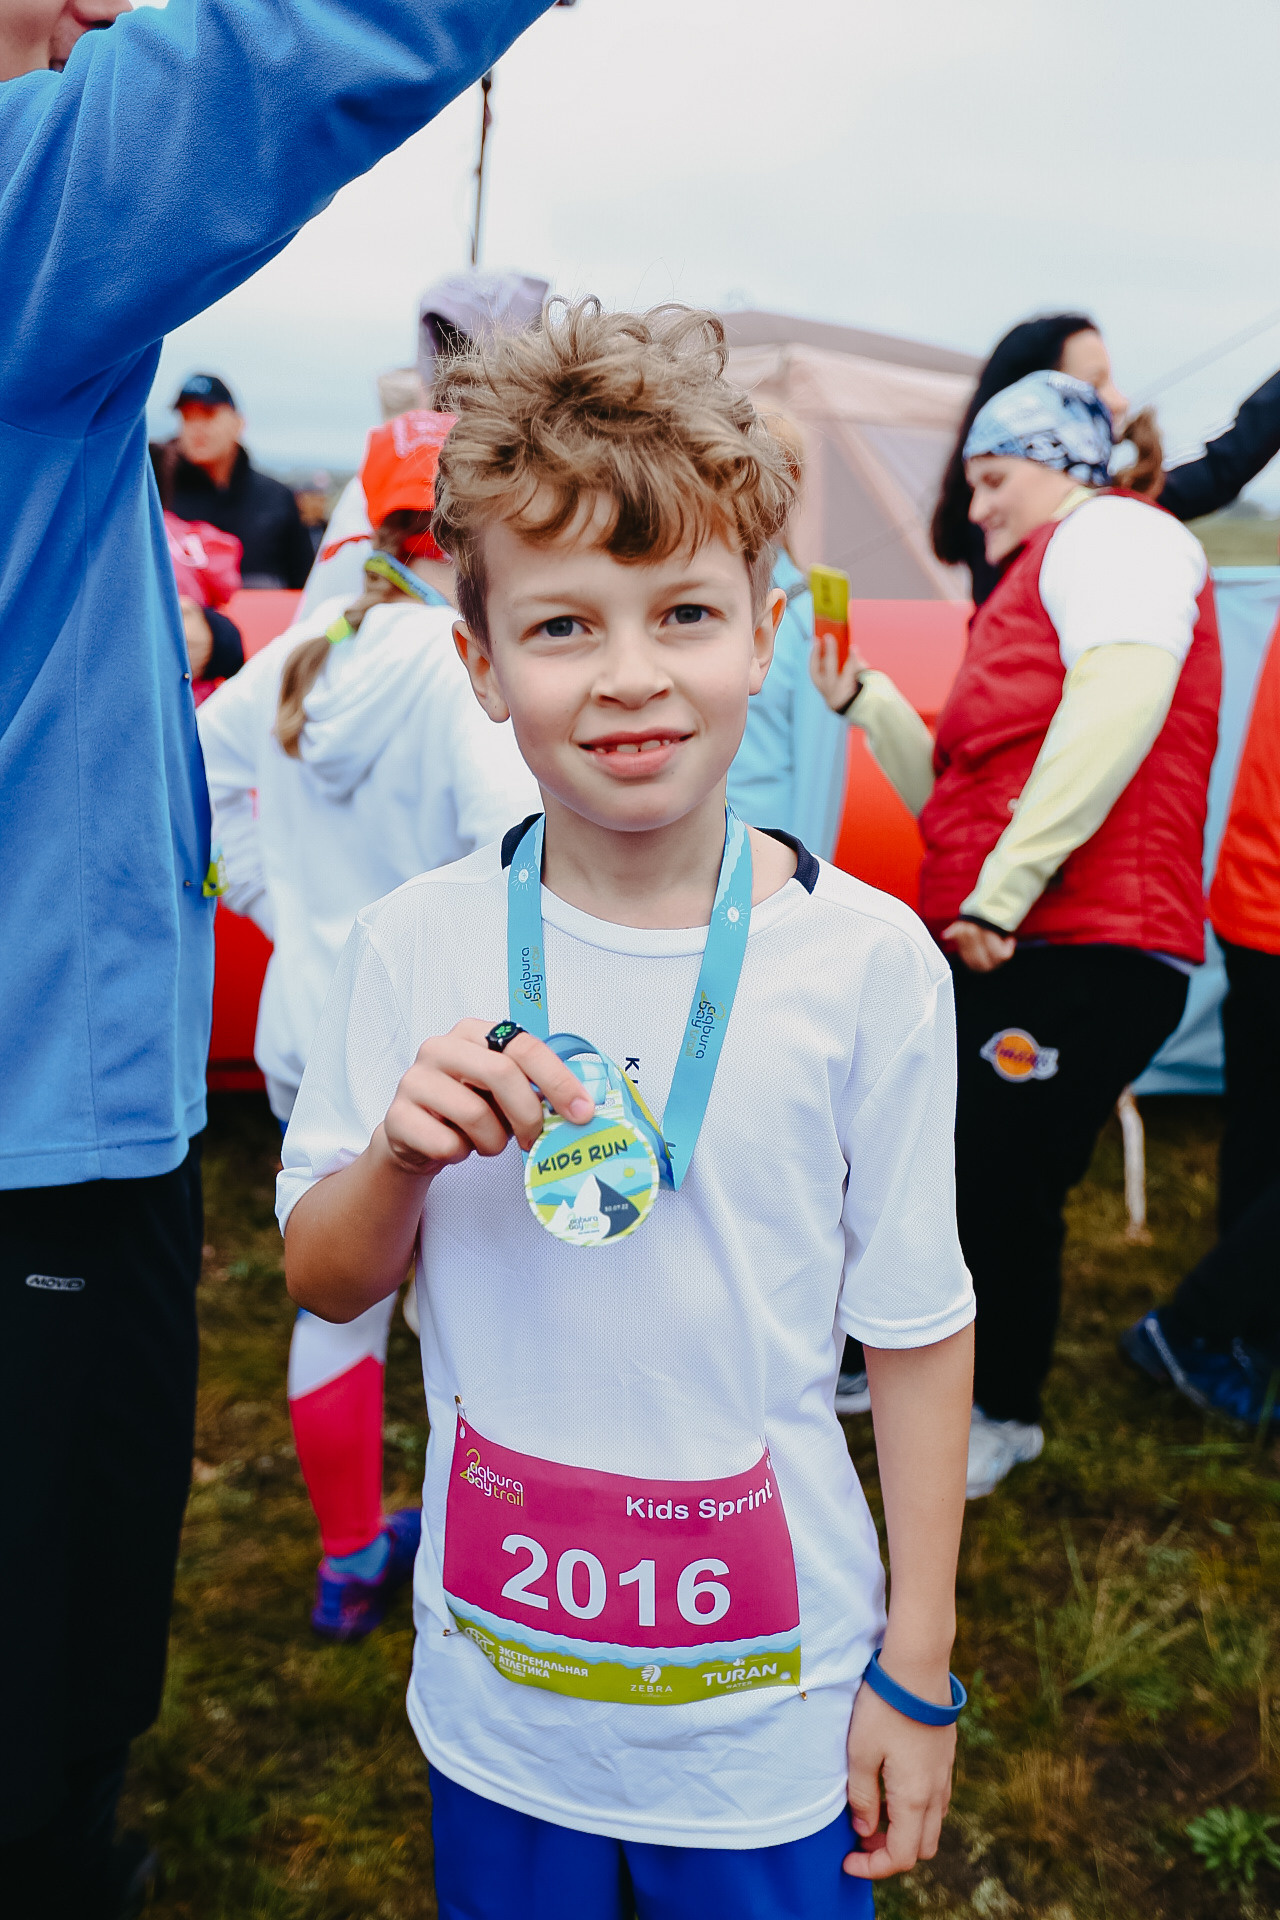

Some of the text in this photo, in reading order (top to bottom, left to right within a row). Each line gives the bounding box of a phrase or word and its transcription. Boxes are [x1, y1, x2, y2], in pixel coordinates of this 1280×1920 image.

[519, 947, 533, 999] aqbura
[530, 974, 543, 1002] bay
[691, 1001, 712, 1028] bay
[695, 1006, 716, 1059] aqbura
[537, 1139, 628, 1175] KIDS RUN
[466, 1466, 524, 1507] bay trail
[469, 1461, 524, 1492] aqbura
[626, 1478, 774, 1522] Kids Sprint
[500, 1533, 732, 1628] 2016
[498, 1645, 589, 1677] ЭКСТРЕМАЛЬНАЯ
[498, 1655, 550, 1679] АТЛЕТИКА
[702, 1662, 778, 1687] TURAN
[630, 1684, 673, 1693] ZEBRA
[725, 1680, 753, 1689] WATER
